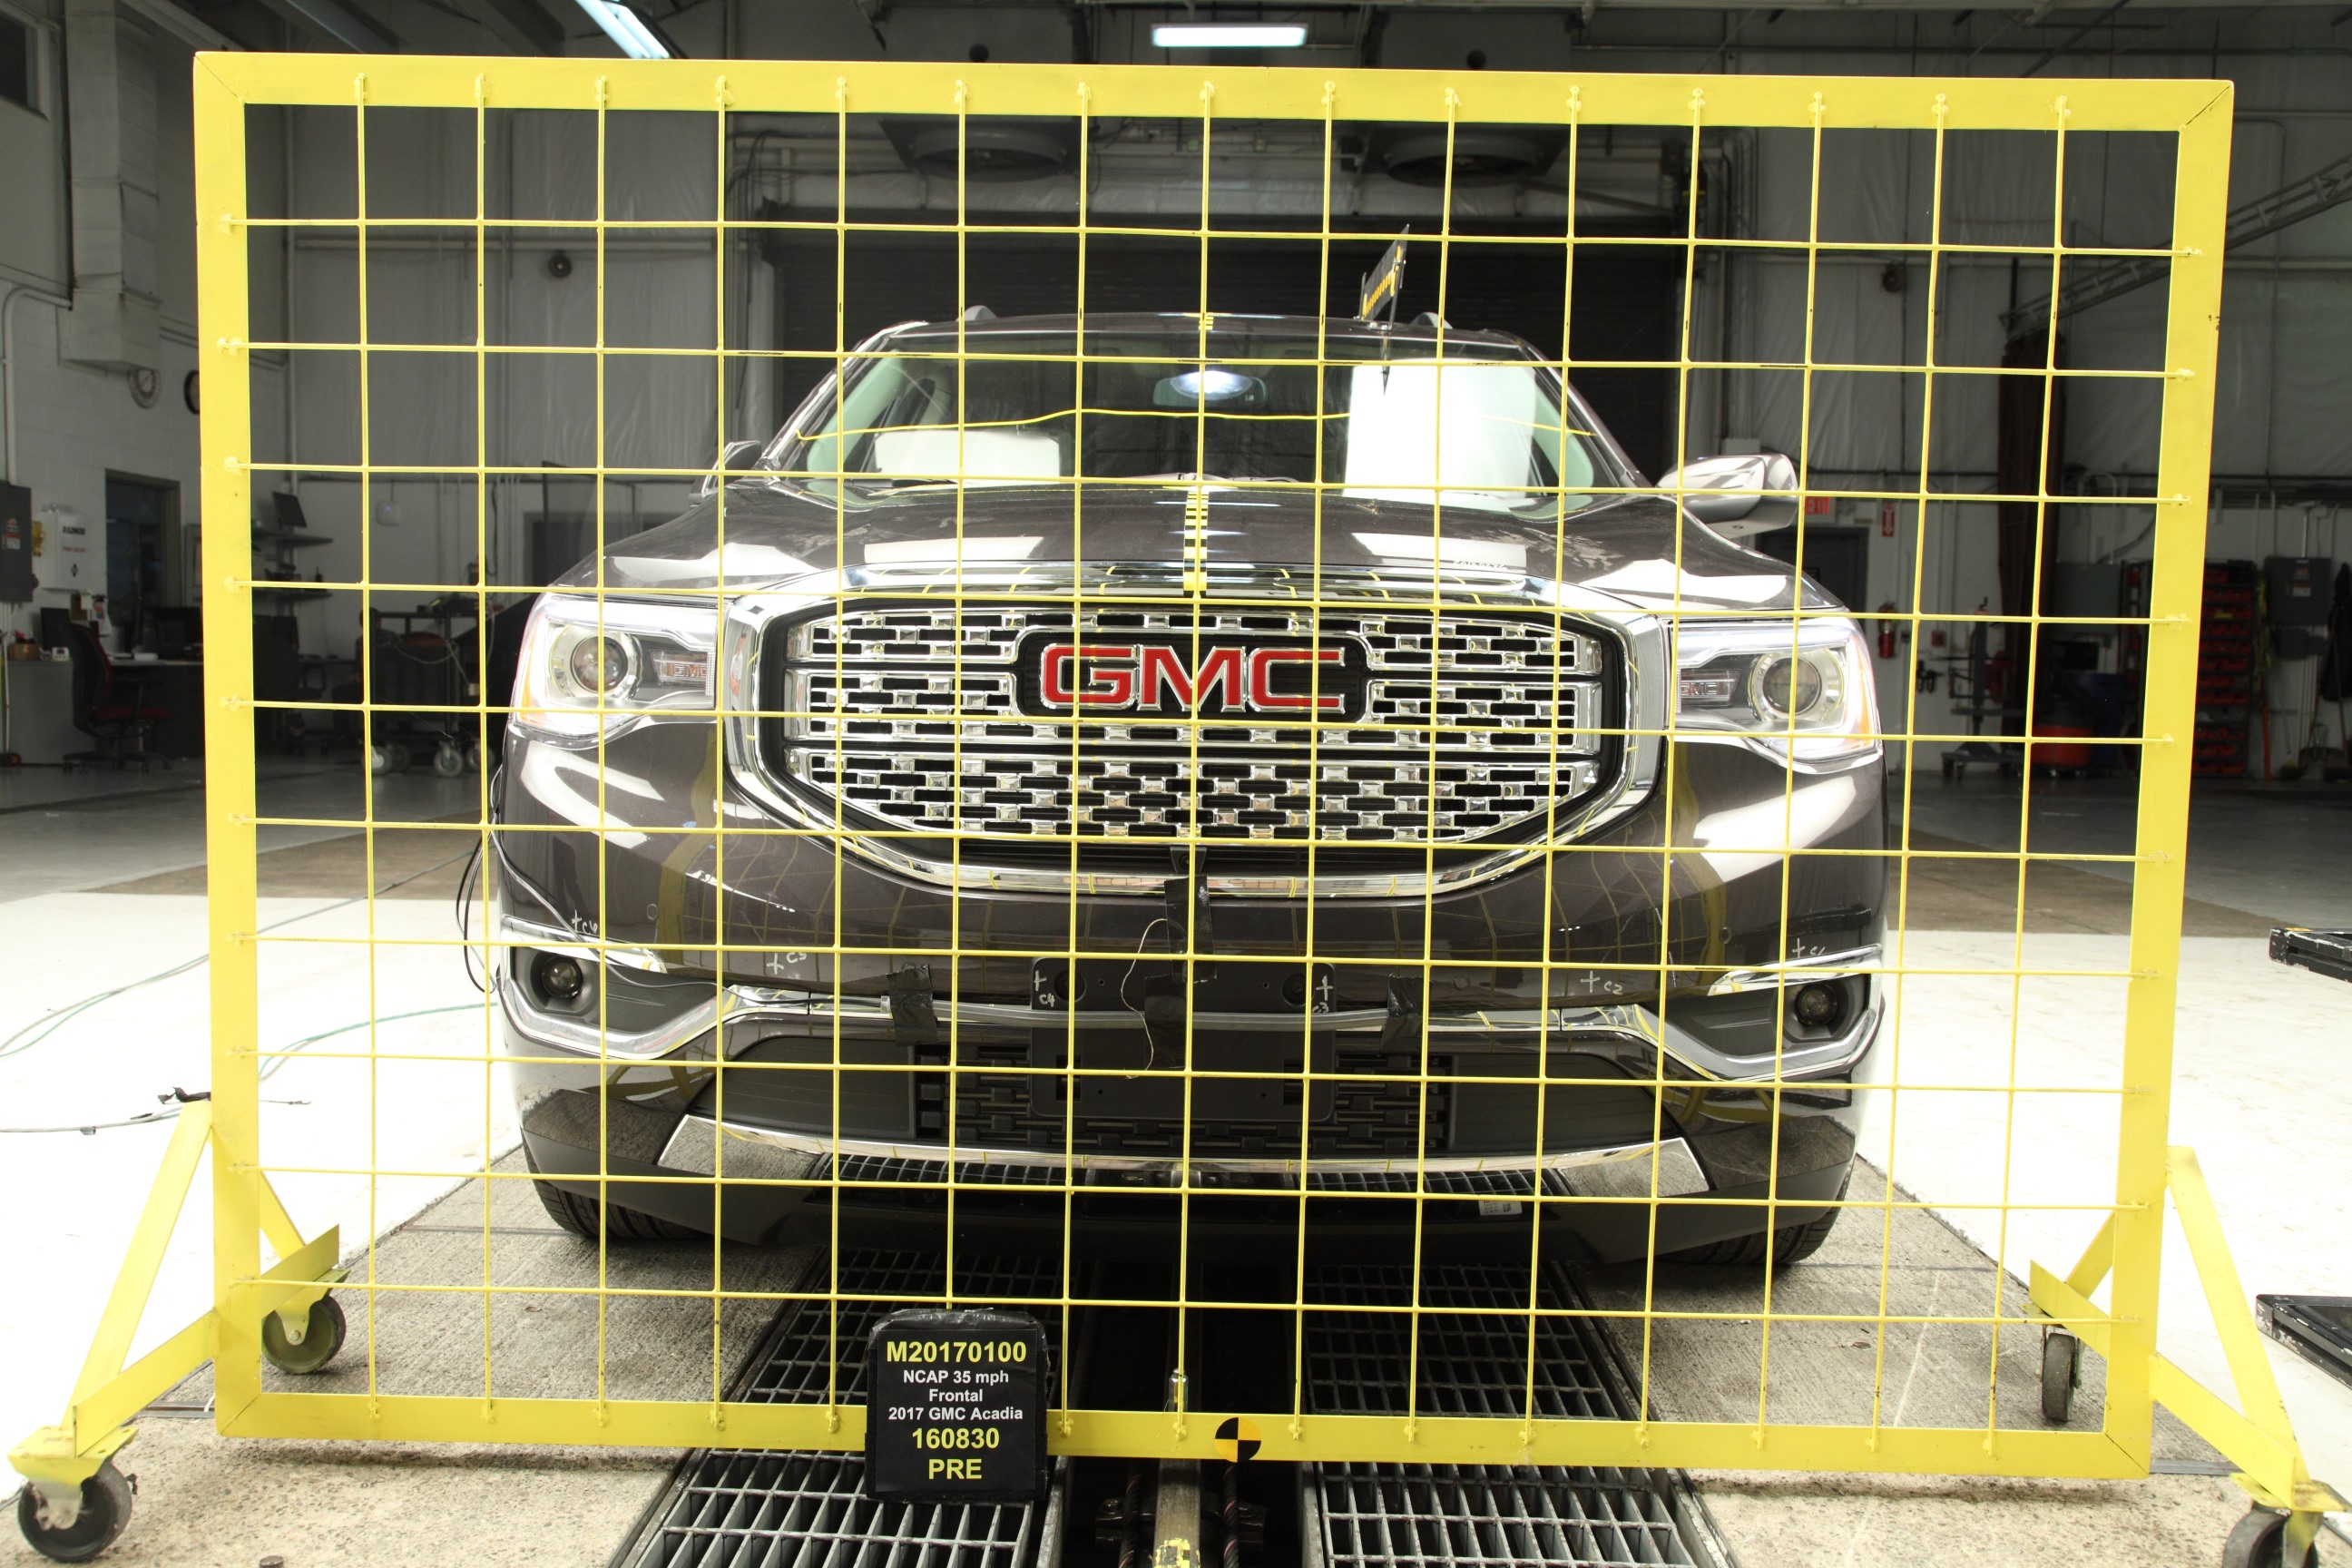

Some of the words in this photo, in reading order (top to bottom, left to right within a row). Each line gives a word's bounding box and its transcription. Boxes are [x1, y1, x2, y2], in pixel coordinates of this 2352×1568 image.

[1041, 643, 1346, 714] GMC
[887, 1341, 1026, 1362] M20170100
[904, 1370, 948, 1383] NCAP
[954, 1371, 971, 1383] 35
[976, 1370, 1008, 1386] mph
[929, 1389, 983, 1402] Frontal
[888, 1407, 924, 1420] 2017
[929, 1407, 965, 1420] GMC
[970, 1406, 1023, 1420] Acadia
[913, 1428, 999, 1448] 160830
[929, 1459, 982, 1479] PRE
